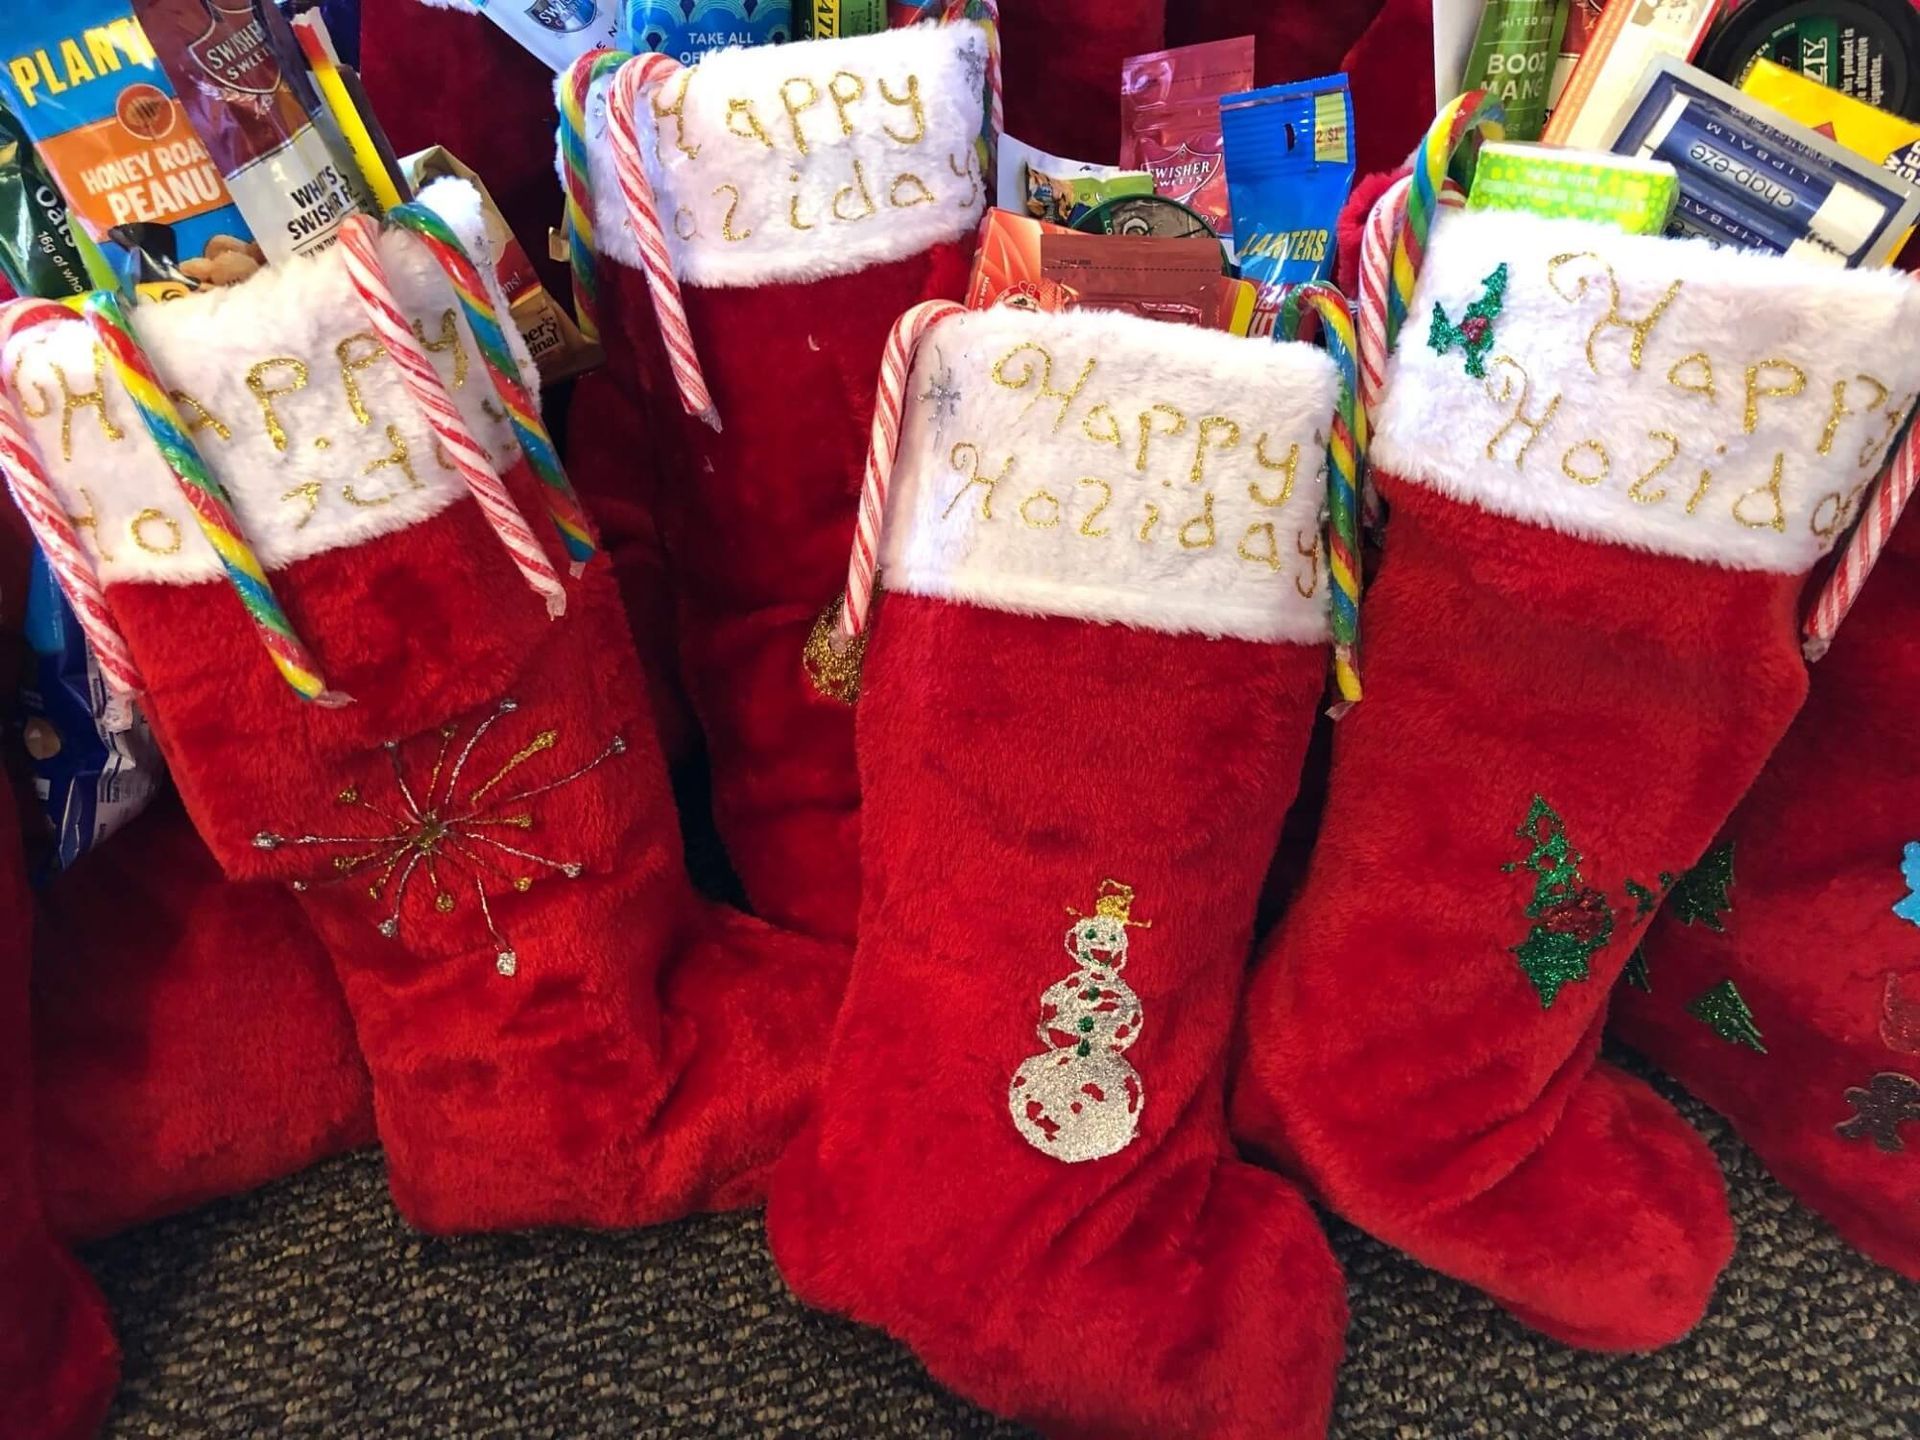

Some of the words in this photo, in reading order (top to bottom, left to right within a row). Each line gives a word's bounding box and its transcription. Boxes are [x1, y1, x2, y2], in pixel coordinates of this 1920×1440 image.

[688, 32, 725, 45] TAKE
[728, 31, 754, 44] ALL
[79, 151, 153, 195] HONEY
[153, 137, 208, 172] ROA
[106, 163, 221, 226] PEANU
[1154, 175, 1202, 188] WEETS
[1689, 143, 1795, 209] chap-eze
[38, 230, 57, 255] 16g
[52, 255, 69, 267] of
[991, 342, 1298, 508] Happy
[942, 442, 1319, 598] Holiday
